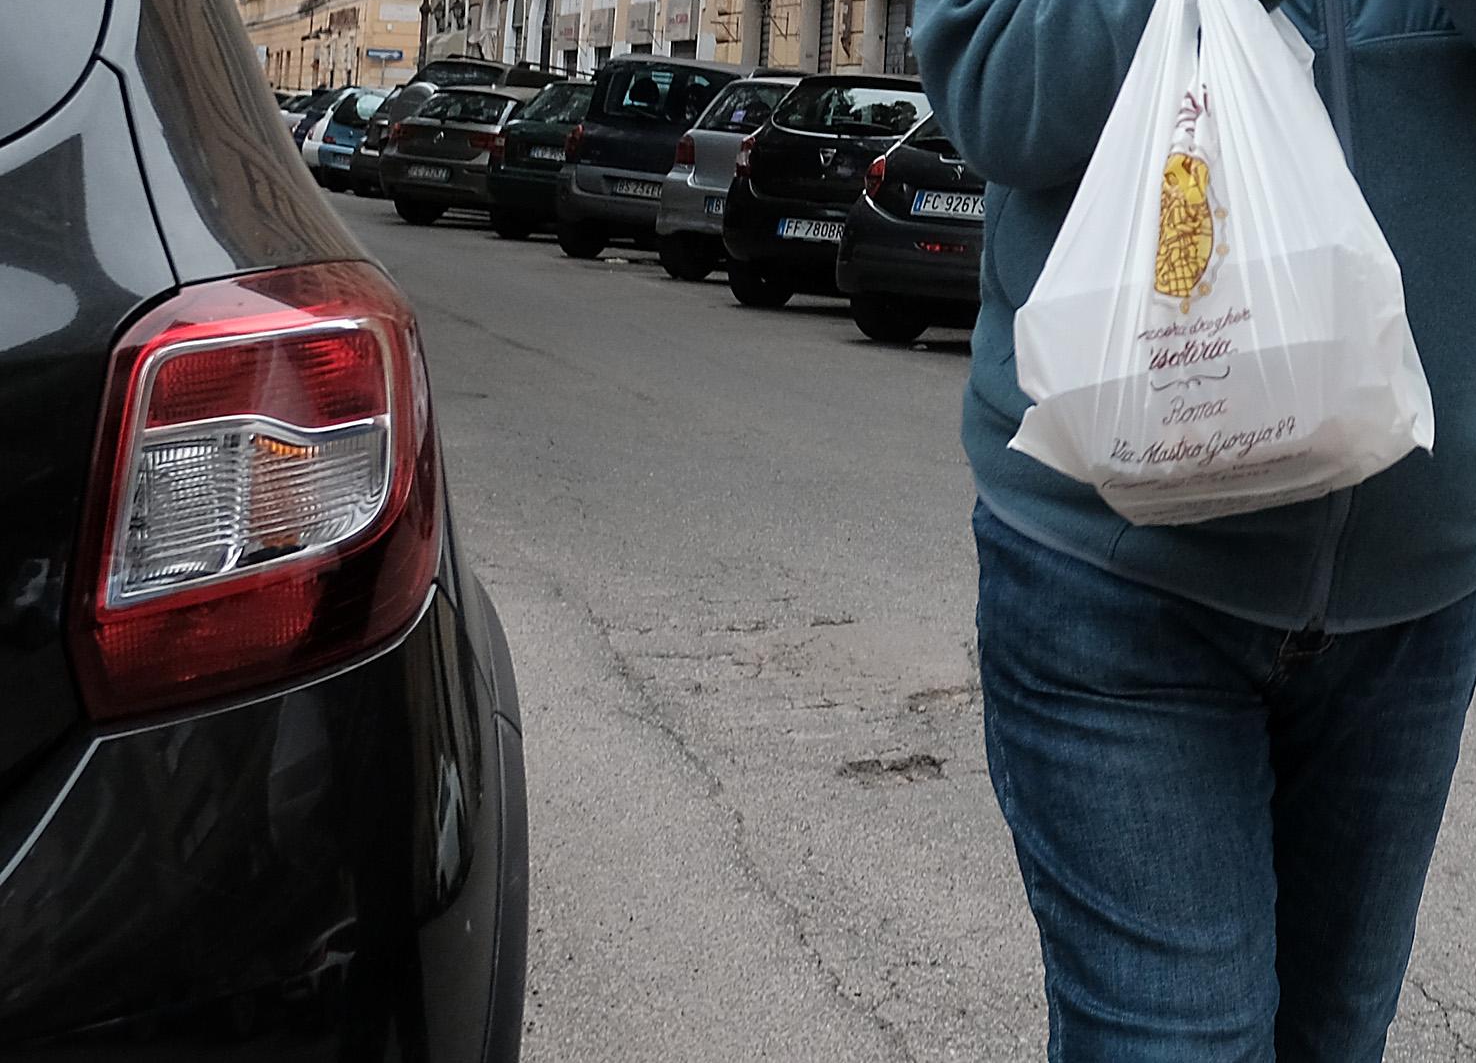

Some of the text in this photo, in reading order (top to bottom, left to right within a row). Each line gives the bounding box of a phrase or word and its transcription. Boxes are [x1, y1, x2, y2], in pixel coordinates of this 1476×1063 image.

[922, 193, 942, 210] FC
[785, 220, 800, 236] FF
[1162, 395, 1229, 426] Roma
[1110, 438, 1135, 464] Via
[1136, 435, 1204, 465] Mastro
[1198, 425, 1274, 468] Giorgio
